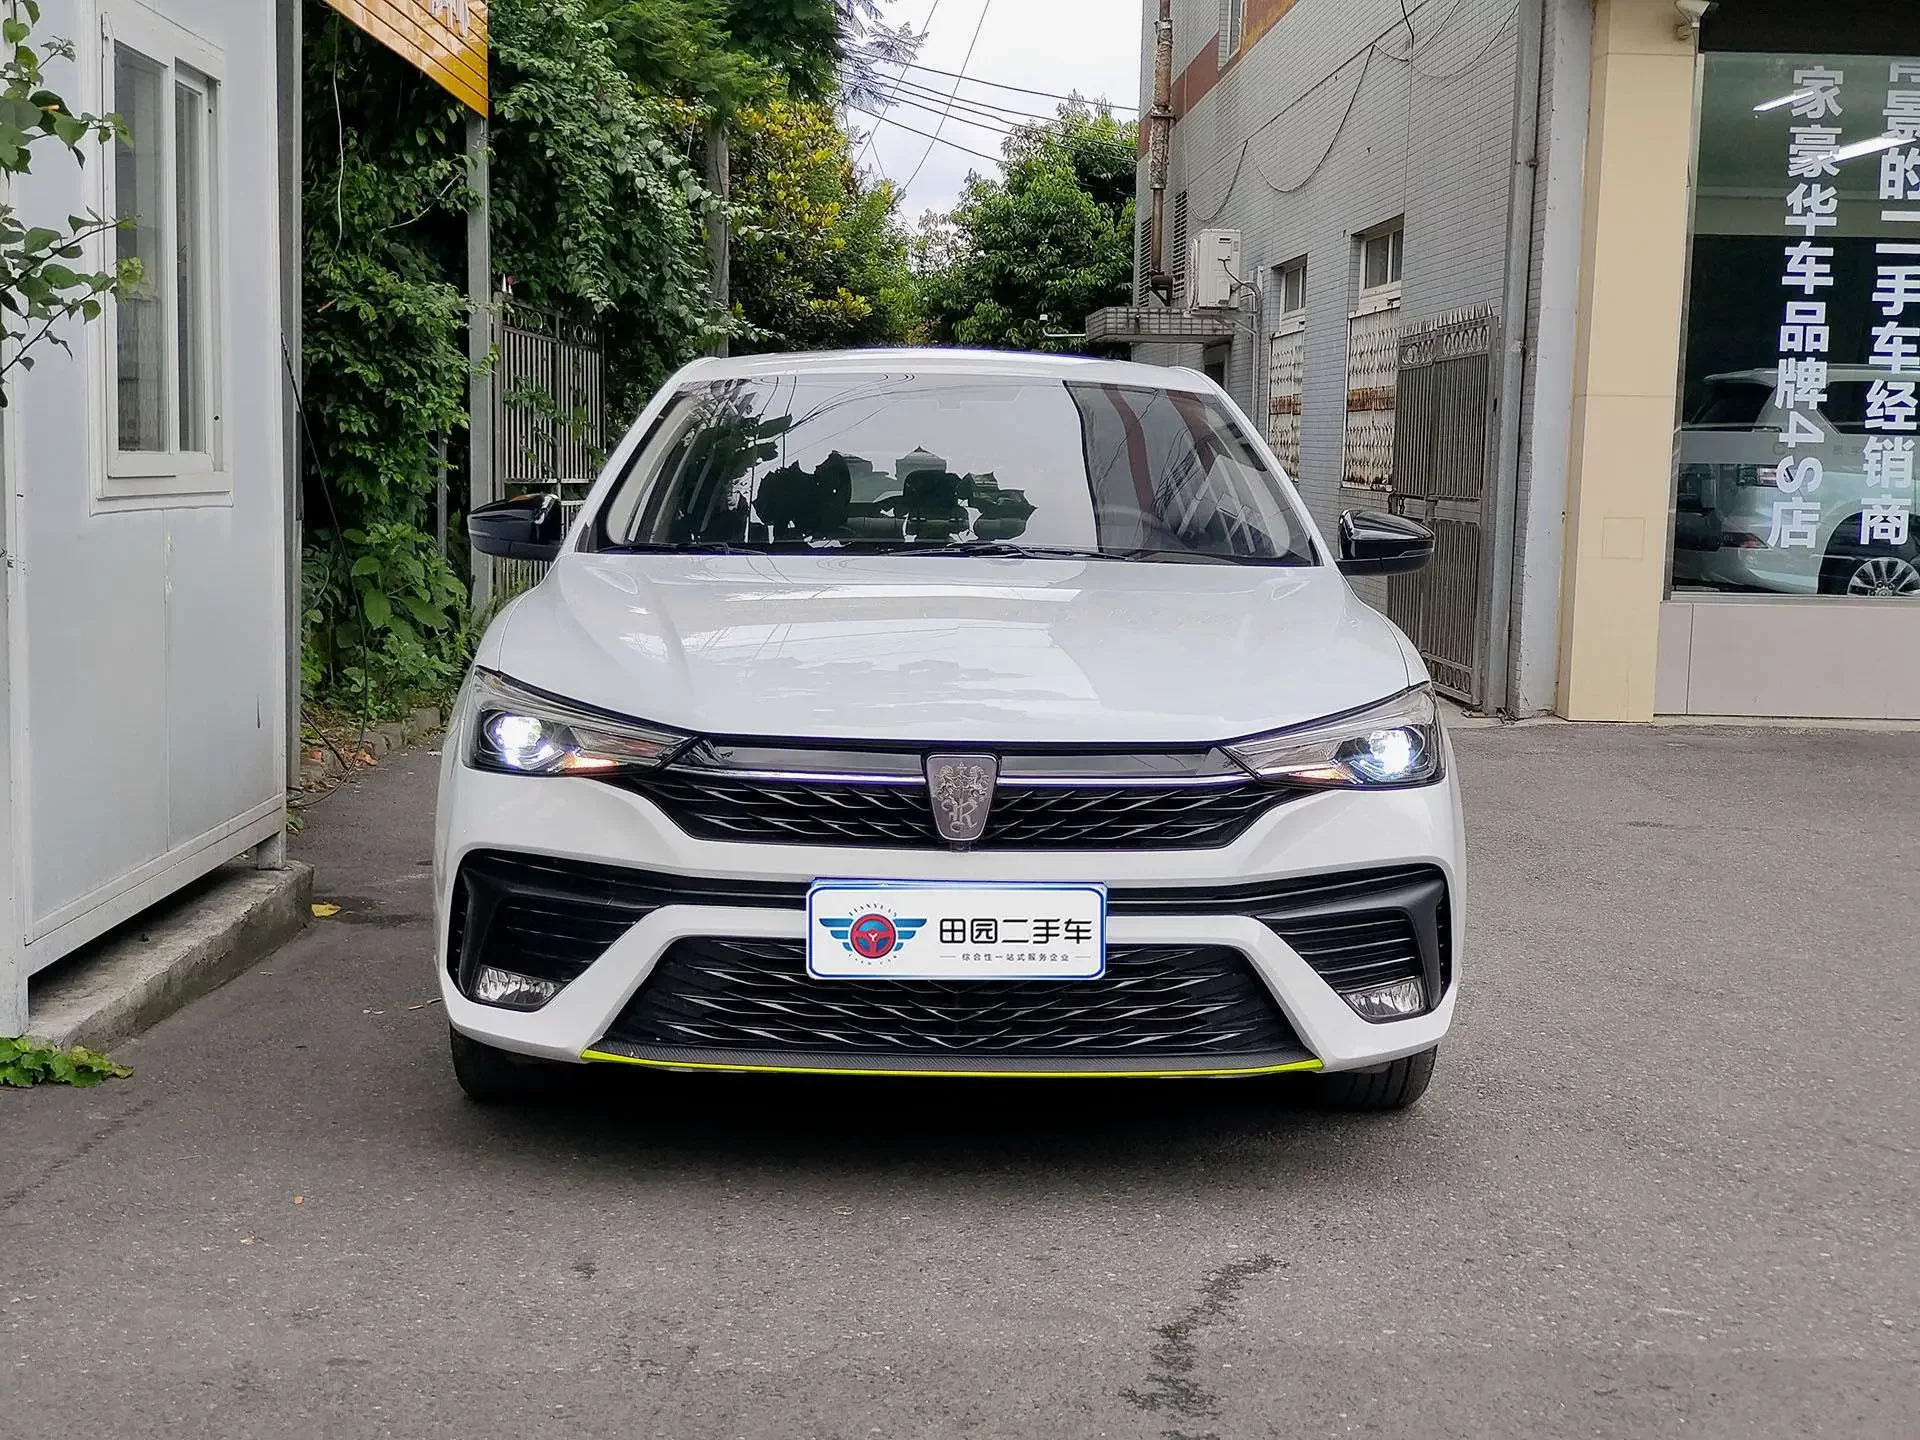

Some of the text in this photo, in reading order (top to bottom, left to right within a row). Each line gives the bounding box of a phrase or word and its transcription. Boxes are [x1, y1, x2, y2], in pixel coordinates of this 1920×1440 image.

[1767, 65, 1843, 549] 家豪华车品牌4S店
[1860, 62, 1920, 545] 景的二手车经销商
[939, 918, 1092, 944] 田园二手车
[962, 952, 1069, 962] 综合性一站式服务企业
